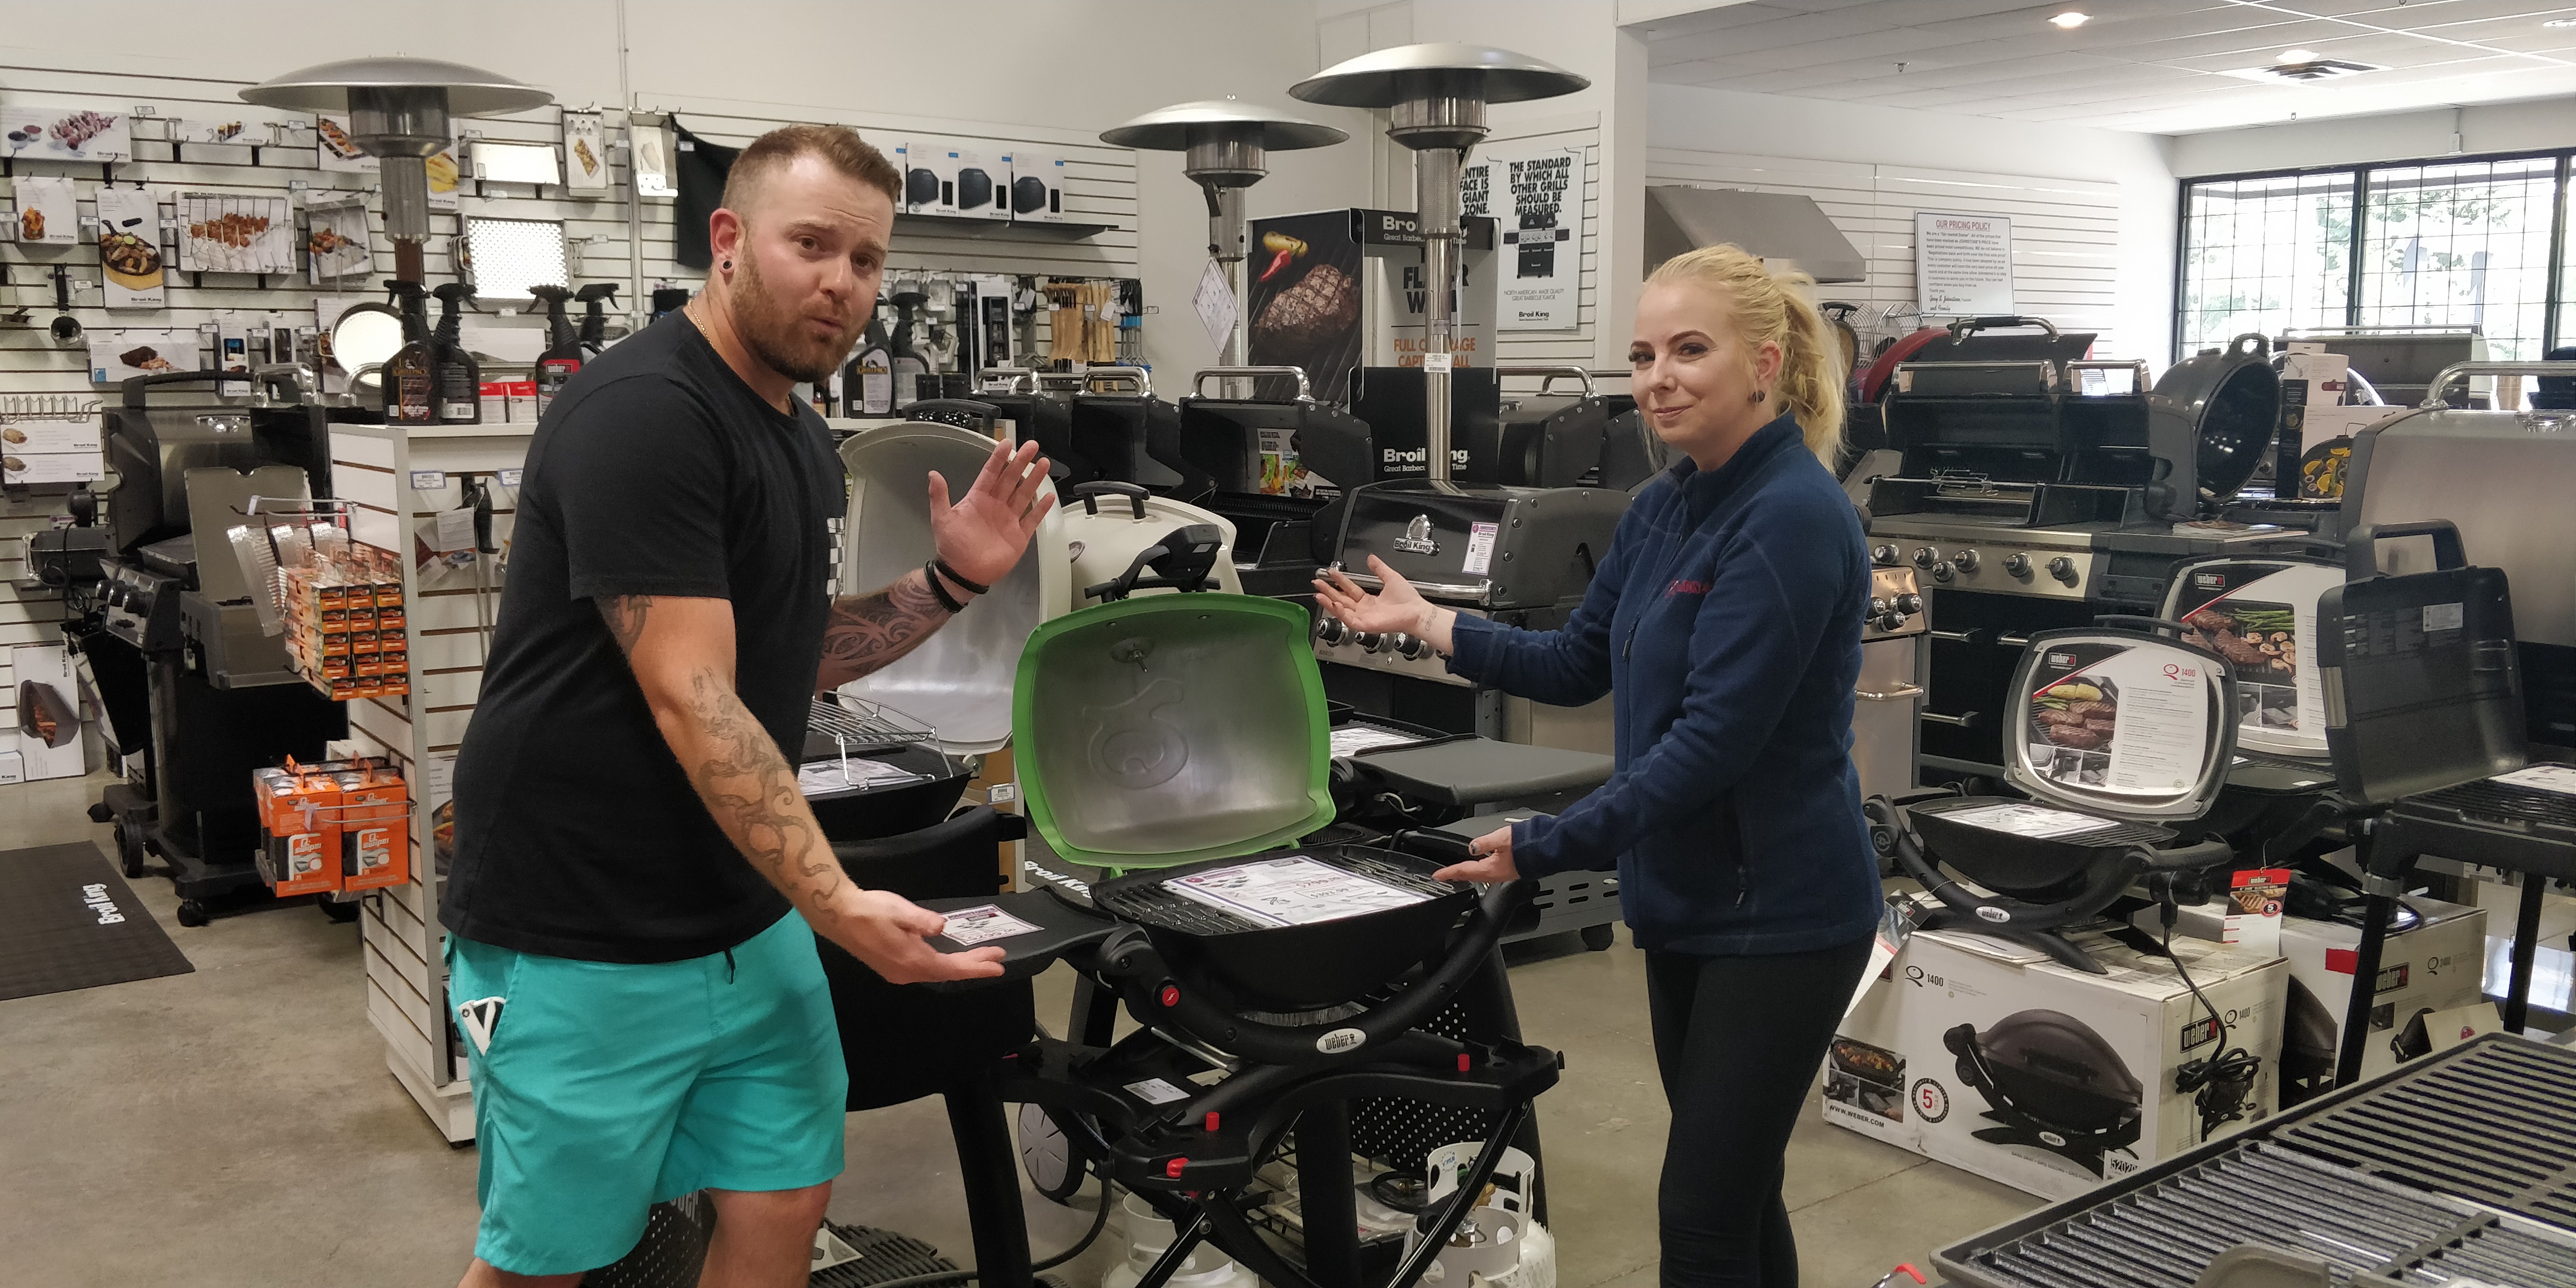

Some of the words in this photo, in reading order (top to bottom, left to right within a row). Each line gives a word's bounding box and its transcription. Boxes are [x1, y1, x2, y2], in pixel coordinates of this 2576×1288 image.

[1462, 165, 1490, 179] NTIRE
[1509, 161, 1524, 173] THE
[1527, 157, 1571, 171] STANDARD
[1510, 173, 1521, 184] BY
[1524, 170, 1553, 182] WHICH
[1555, 168, 1569, 180] ALL
[1481, 178, 1489, 190] IS
[1511, 183, 1537, 195] OTHER
[1540, 179, 1568, 192] GRILLS
[1462, 190, 1490, 203] GIANT
[1516, 193, 1550, 206] SHOULD
[1552, 191, 1562, 202] BE
[1464, 203, 1490, 215] ZONE.
[1515, 203, 1562, 216] MEASURED.
[1382, 216, 1418, 231] Bro
[1936, 220, 1948, 228] OUR
[1949, 220, 1971, 229] PRICING
[1972, 221, 1991, 230] POLICY
[1394, 339, 1416, 352] FULL
[1384, 447, 1426, 462] Broil
[1394, 537, 1412, 549] Broil
[1413, 541, 1431, 552] King
[2196, 573, 2218, 585] weber
[2050, 653, 2070, 664] weber
[2181, 667, 2196, 677] 1400
[1025, 860, 1069, 881] Broil
[83, 883, 111, 904] King
[88, 901, 125, 925] Broil
[1982, 908, 1999, 919] weber
[1927, 973, 1944, 987] 1400
[2239, 1007, 2251, 1020] 1400
[1325, 1033, 1349, 1050] weber
[2184, 1020, 2210, 1048] weber
[1922, 1088, 1933, 1109] 5
[1829, 1104, 1884, 1128] WWW.WEBER.COM
